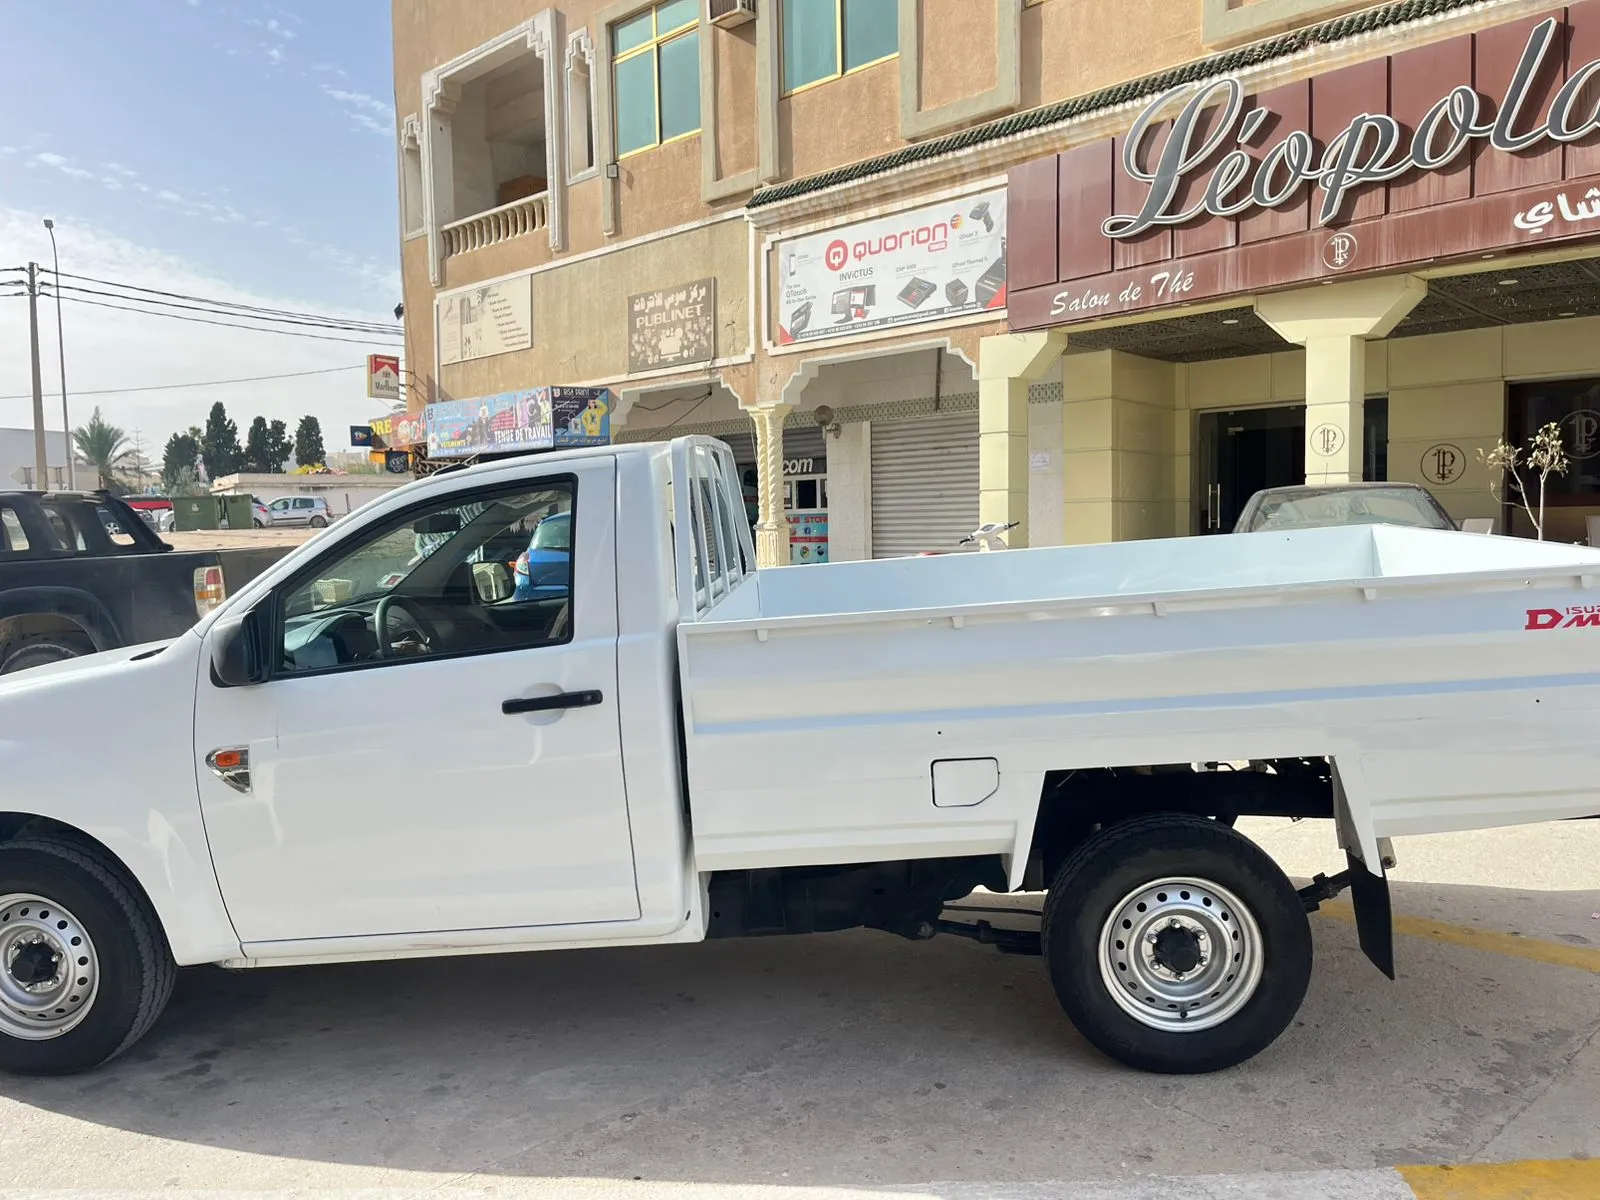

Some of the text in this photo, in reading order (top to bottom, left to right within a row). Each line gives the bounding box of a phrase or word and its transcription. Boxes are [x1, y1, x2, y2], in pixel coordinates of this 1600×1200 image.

[1049, 270, 1194, 315] Salon de Thé
[636, 303, 704, 329] PUBLINET
[494, 424, 552, 443] TENUE DE TRAVAIL
[1565, 605, 1600, 615] ISU
